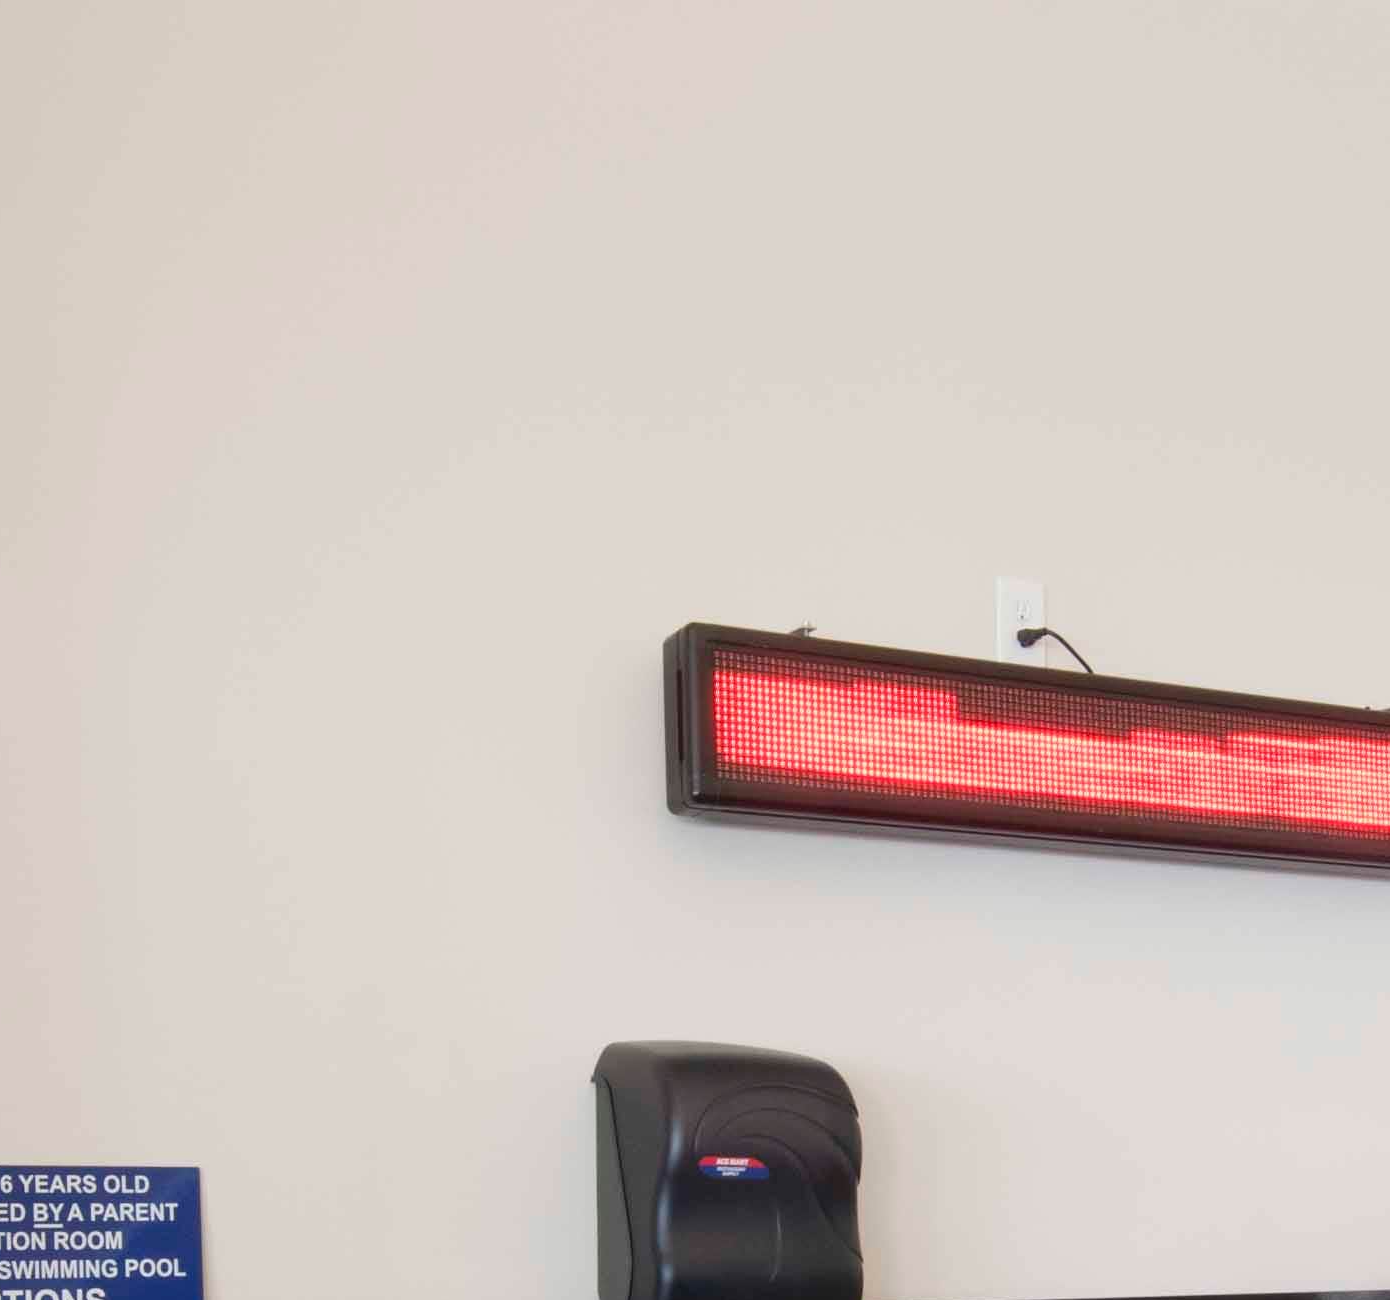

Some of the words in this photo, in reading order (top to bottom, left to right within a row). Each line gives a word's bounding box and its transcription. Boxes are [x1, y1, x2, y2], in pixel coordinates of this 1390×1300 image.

[19, 1174, 97, 1193] YEARS
[104, 1175, 150, 1194] OLD
[34, 1203, 63, 1225] BY
[67, 1203, 84, 1222] A
[91, 1203, 178, 1222] PARENT
[54, 1231, 123, 1251] ROOM
[125, 1258, 186, 1278] POOL
